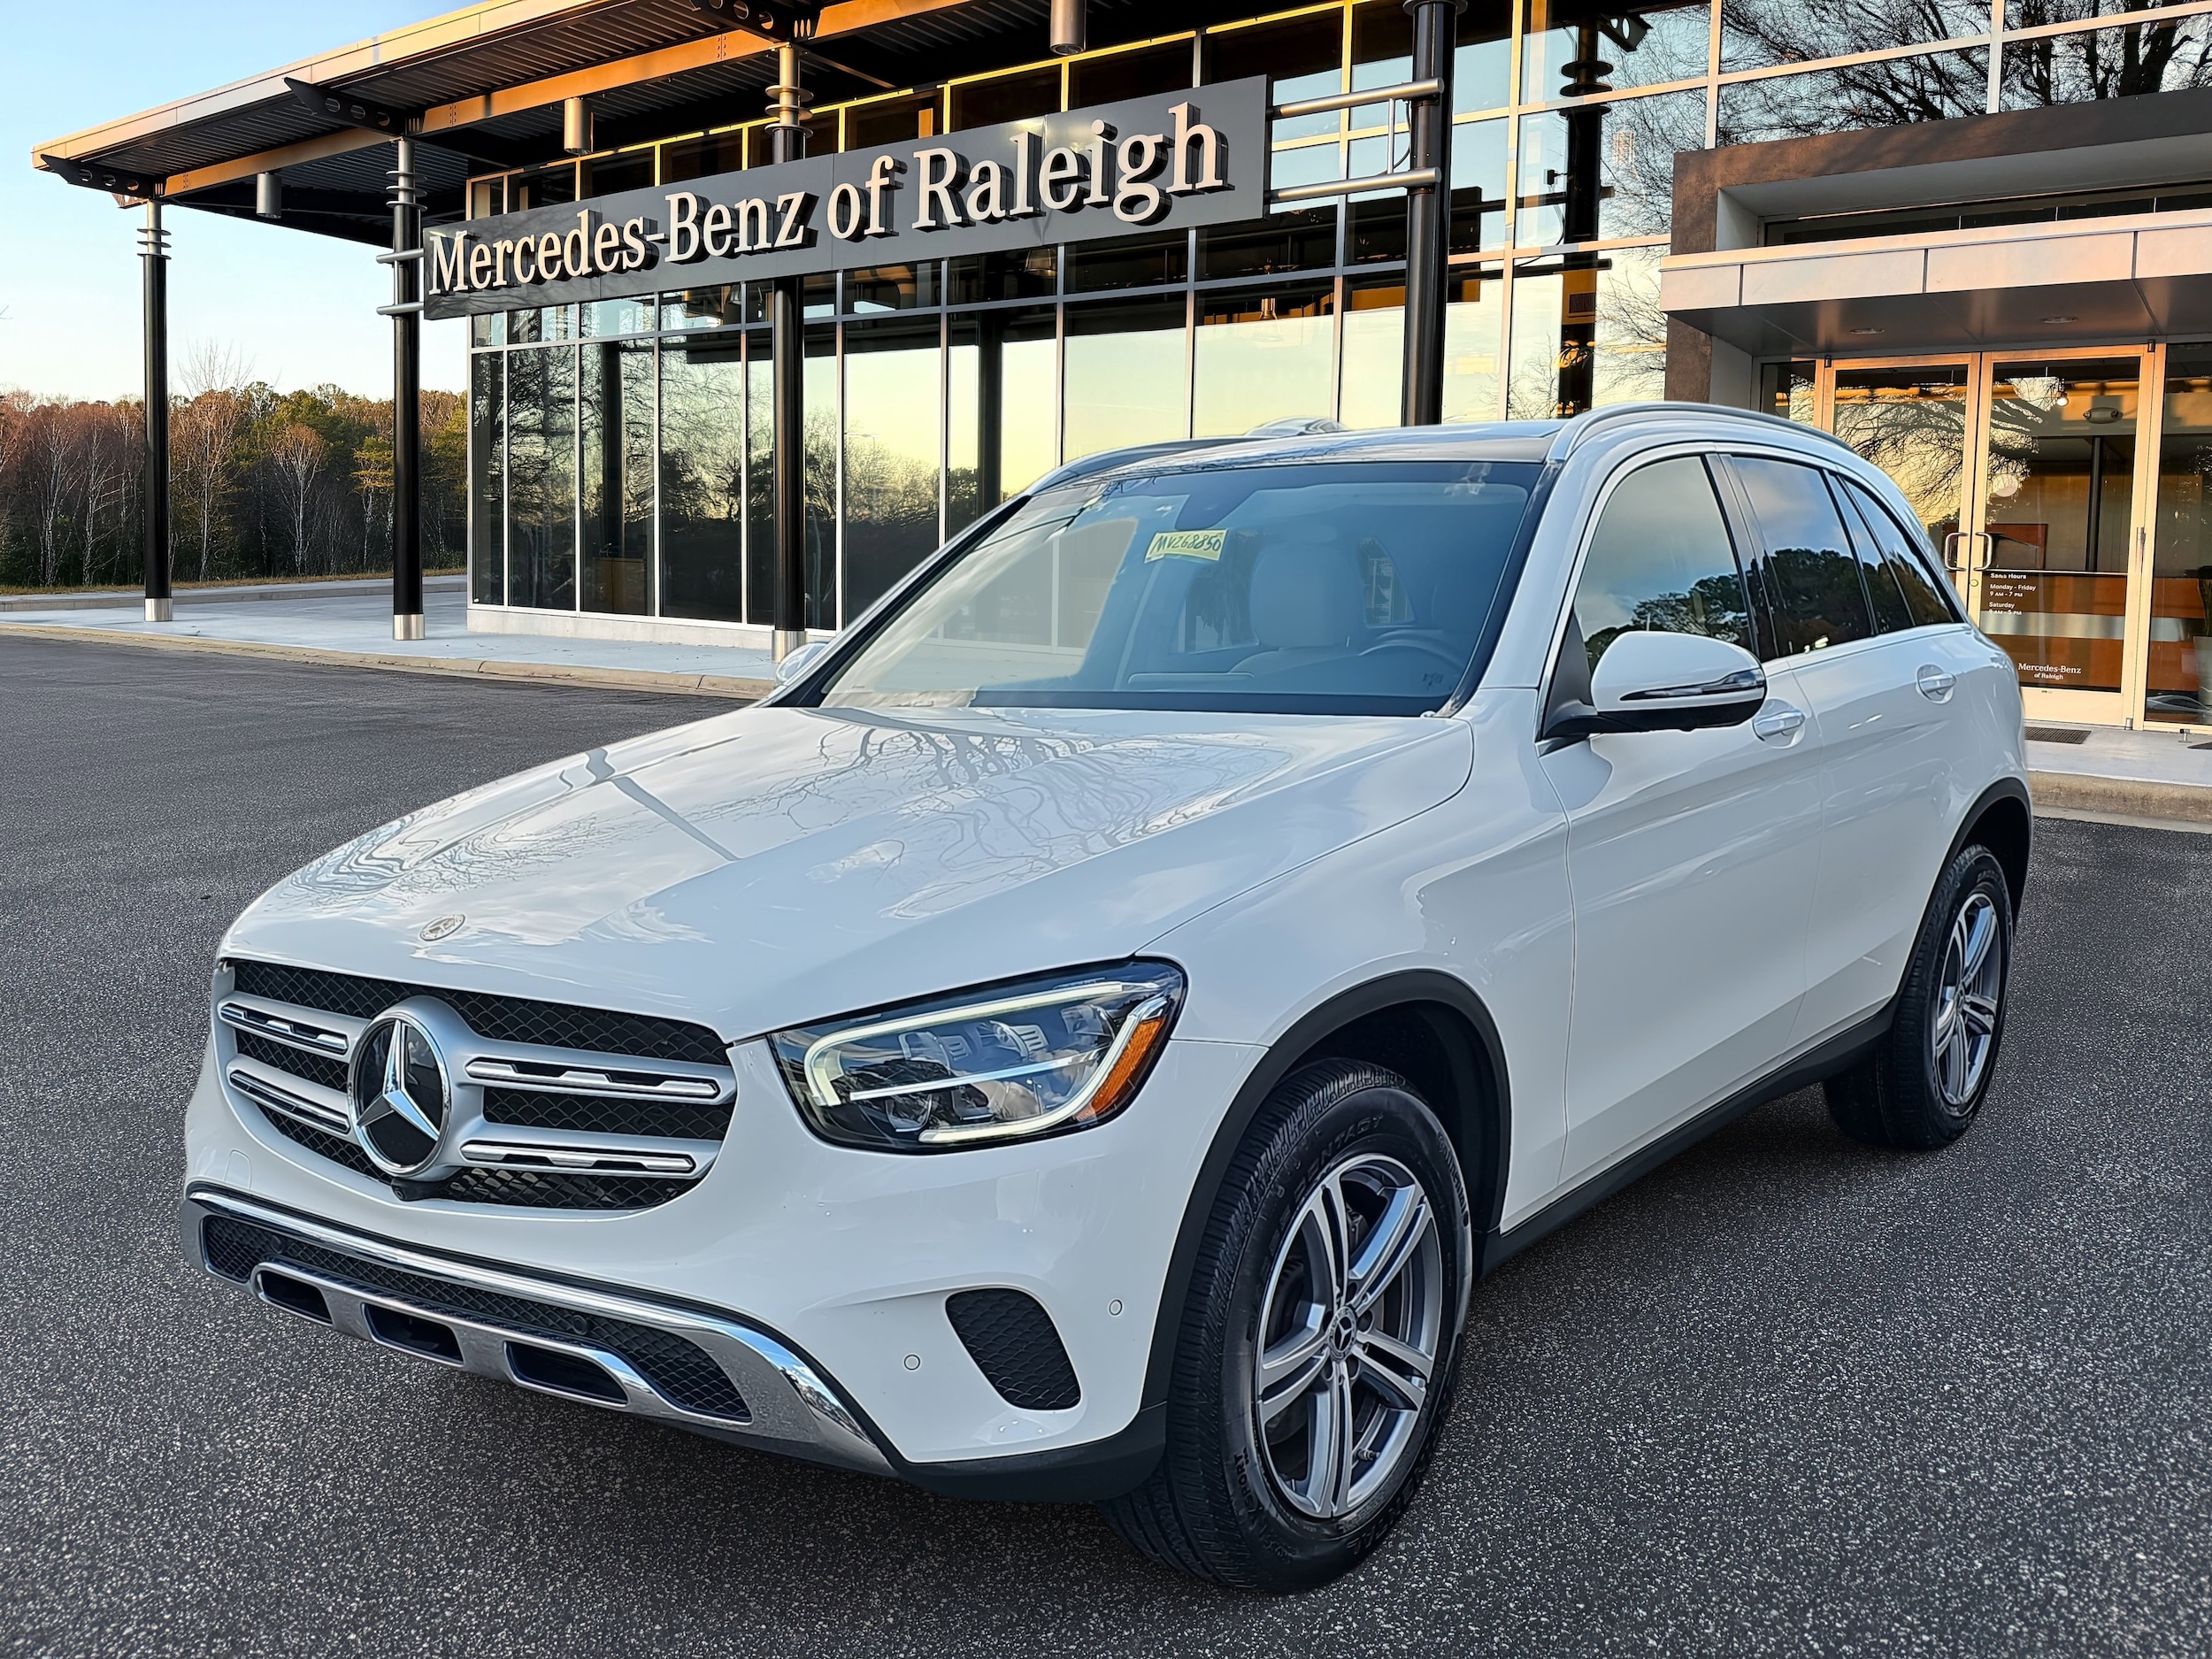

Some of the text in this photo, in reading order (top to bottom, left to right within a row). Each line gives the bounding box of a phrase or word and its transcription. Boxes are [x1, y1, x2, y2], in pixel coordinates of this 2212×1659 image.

[428, 102, 1225, 295] Mercedes-Benz of Raleigh
[2018, 663, 2082, 674] Mercedes-Benz
